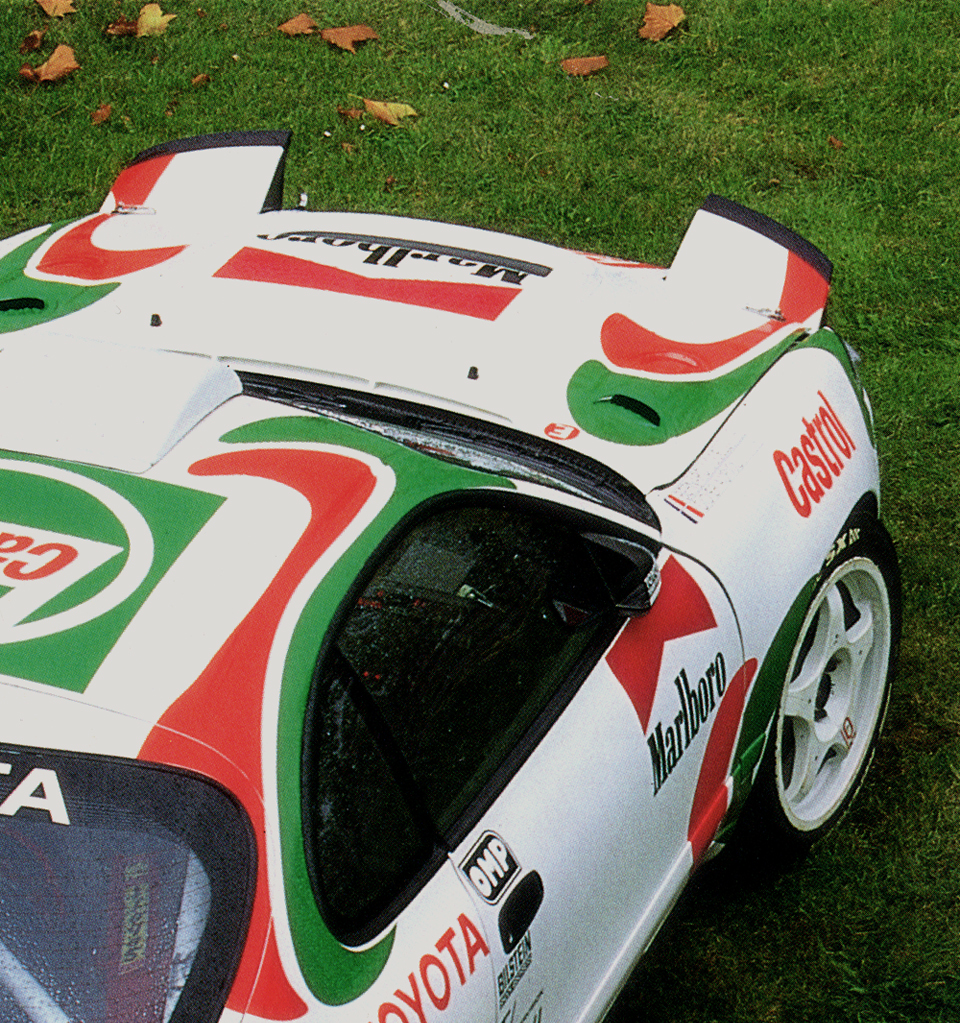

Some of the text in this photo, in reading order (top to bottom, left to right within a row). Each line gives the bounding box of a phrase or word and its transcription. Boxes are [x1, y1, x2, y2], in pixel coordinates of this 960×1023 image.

[773, 390, 857, 519] Castrol
[646, 652, 726, 797] Marlboro
[469, 838, 509, 898] OMP
